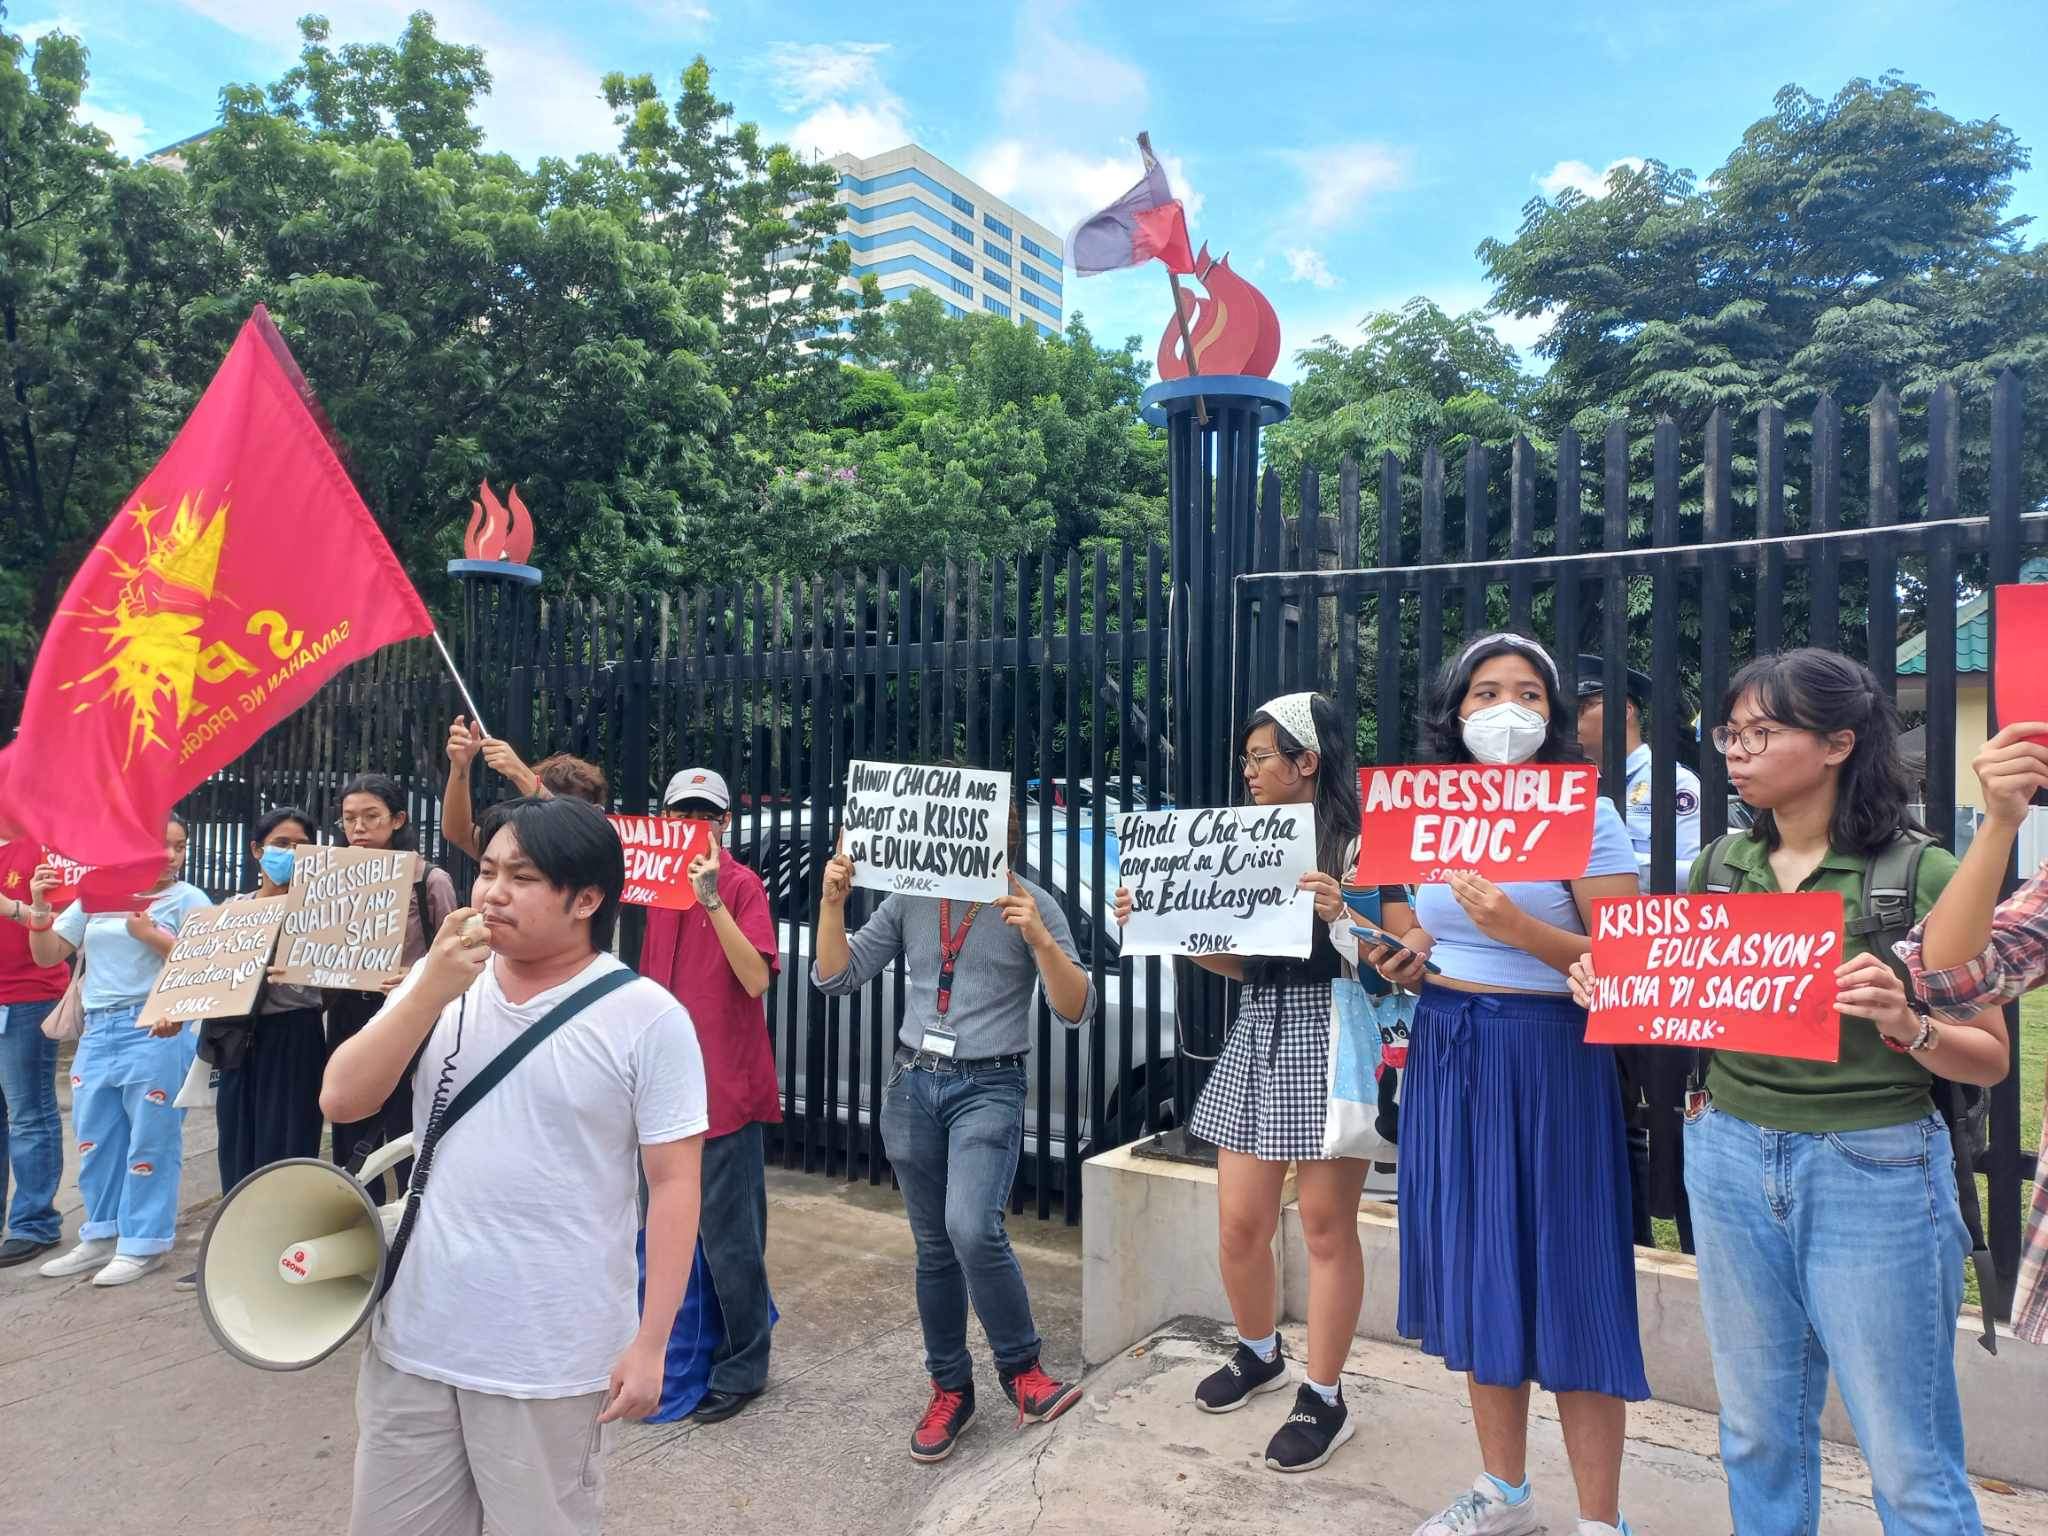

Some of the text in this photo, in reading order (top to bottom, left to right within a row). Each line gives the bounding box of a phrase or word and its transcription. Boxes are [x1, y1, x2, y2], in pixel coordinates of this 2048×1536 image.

[852, 763, 891, 793] HINDI
[965, 780, 997, 802] ANG
[1365, 769, 1588, 815] ACCESSIBLE
[845, 796, 990, 842] SAGOT SA KRISIS
[1118, 808, 1299, 855] Hindi Cha-cha
[850, 835, 1004, 879] SA EDUKASYON!
[1411, 814, 1550, 864] EDUC!
[292, 848, 338, 887] FREE
[304, 854, 407, 906] ACCESSIBLE
[1120, 843, 1285, 888] ang sagot sa Krisis
[210, 904, 284, 933] Accessible
[284, 888, 398, 935] QUALITY AND
[1132, 879, 1299, 919] sa Edukasyon!
[345, 909, 401, 946] SAFE
[1598, 898, 1730, 941] KRISIS SA
[169, 935, 224, 962] Quality
[231, 928, 266, 953] Safe
[287, 937, 402, 971] EDUCATION!
[1647, 931, 1836, 970] EDUKASYON?
[157, 964, 232, 993] Education
[1699, 974, 1814, 1013] SAGOT!
[282, 1259, 306, 1277] CROWN
